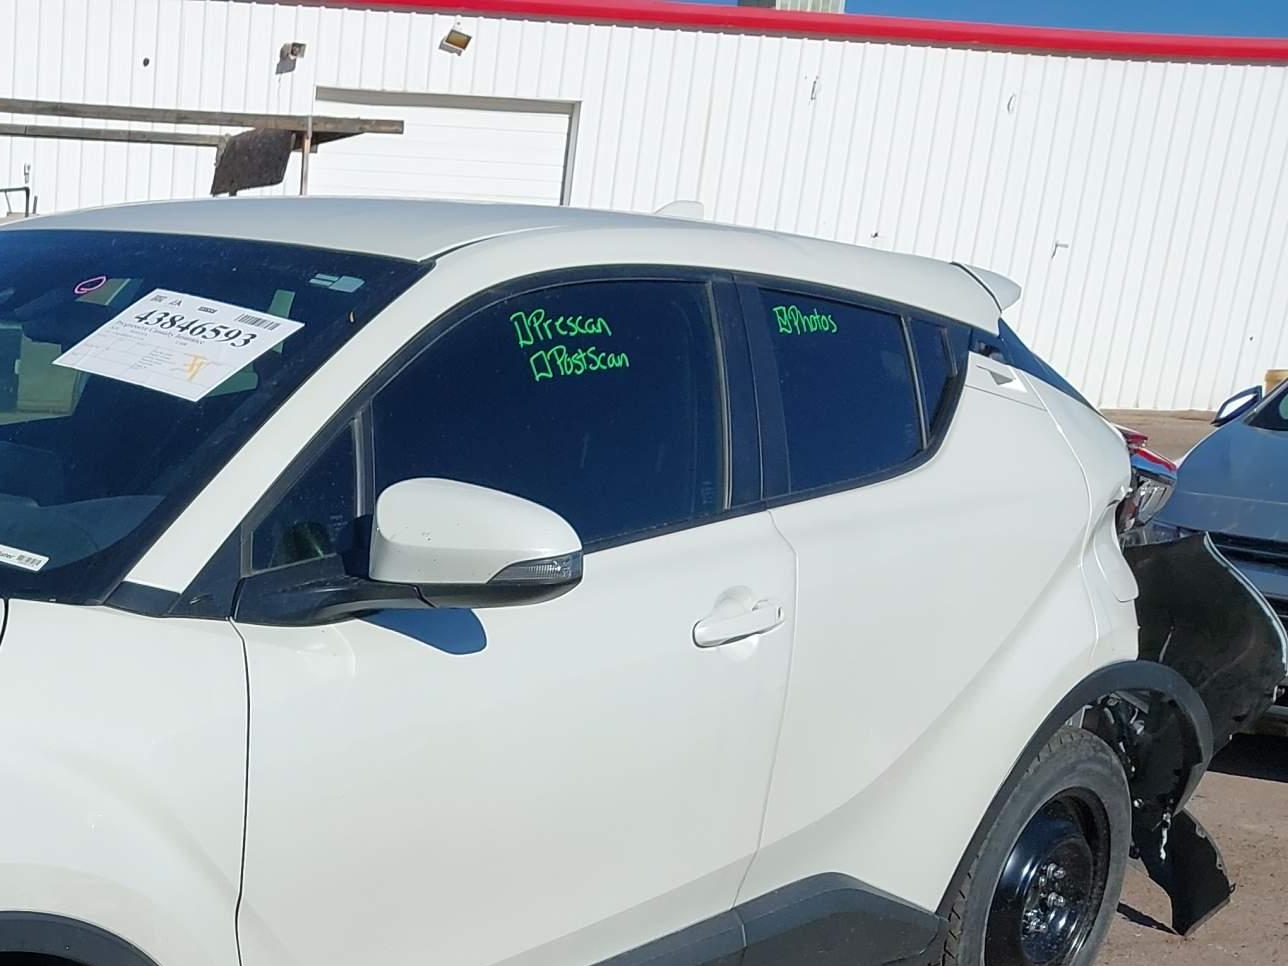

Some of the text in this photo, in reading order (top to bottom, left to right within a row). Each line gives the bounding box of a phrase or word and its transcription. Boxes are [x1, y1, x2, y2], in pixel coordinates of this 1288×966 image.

[134, 309, 257, 348] 43846593
[527, 308, 613, 341] Prescan
[787, 304, 838, 335] Photos
